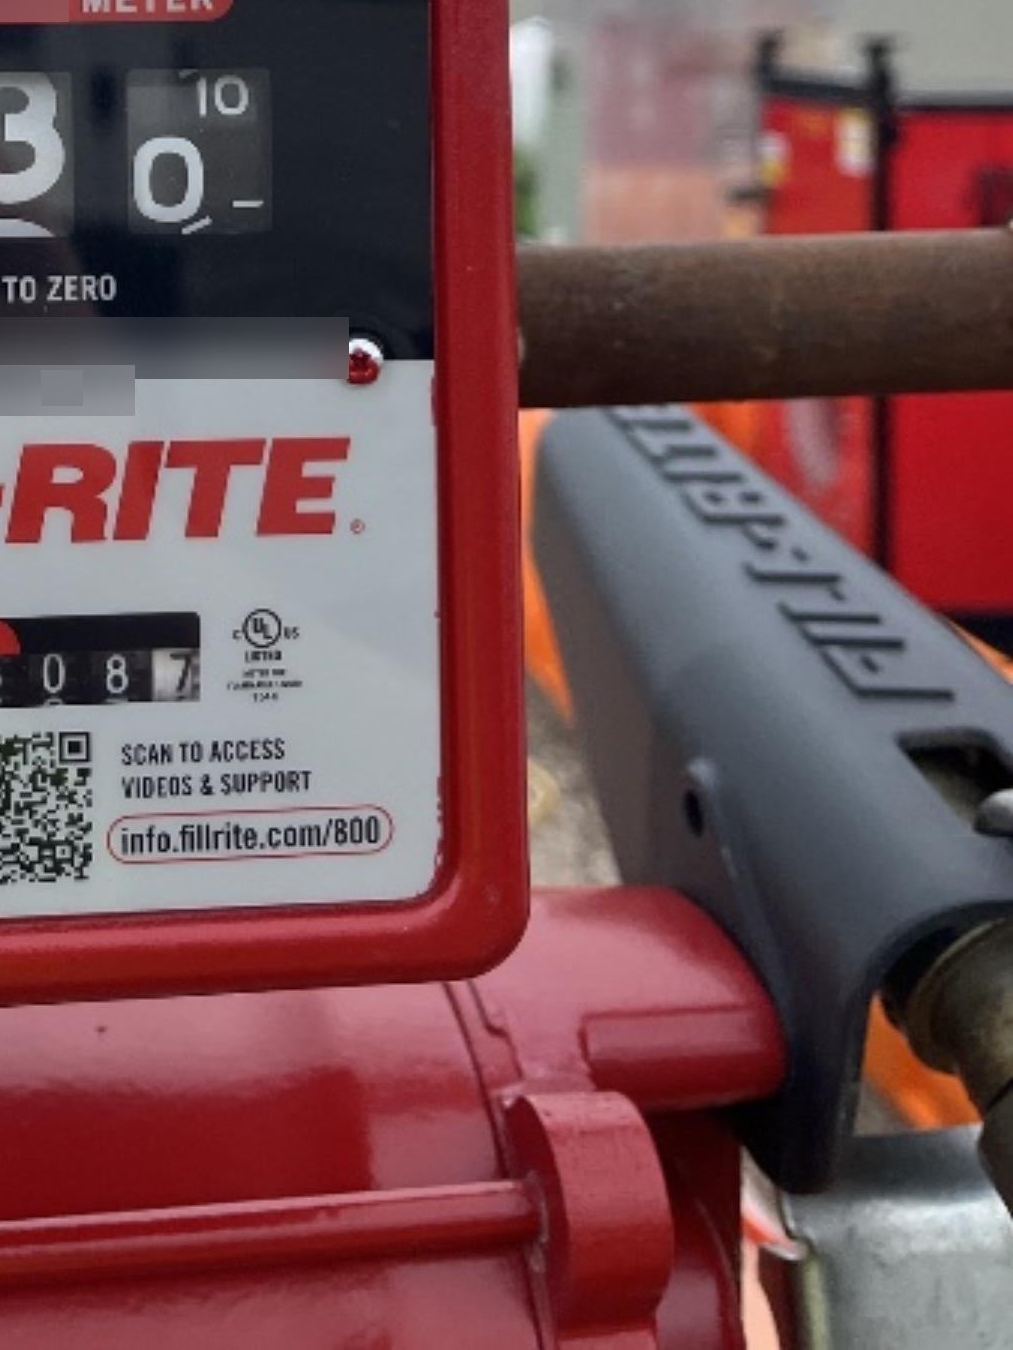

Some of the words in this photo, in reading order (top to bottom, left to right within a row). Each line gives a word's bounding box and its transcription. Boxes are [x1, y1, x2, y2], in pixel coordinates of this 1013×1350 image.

[2, 275, 36, 303] TO
[46, 273, 117, 301] ZERO
[121, 742, 173, 766] SCAN
[179, 740, 202, 763] TO
[209, 737, 285, 763] ACCESS
[121, 774, 192, 798] VIDEOS
[200, 773, 214, 796] &
[220, 770, 312, 794] SUPPORT
[121, 815, 380, 855] info.fillrite.com/800
